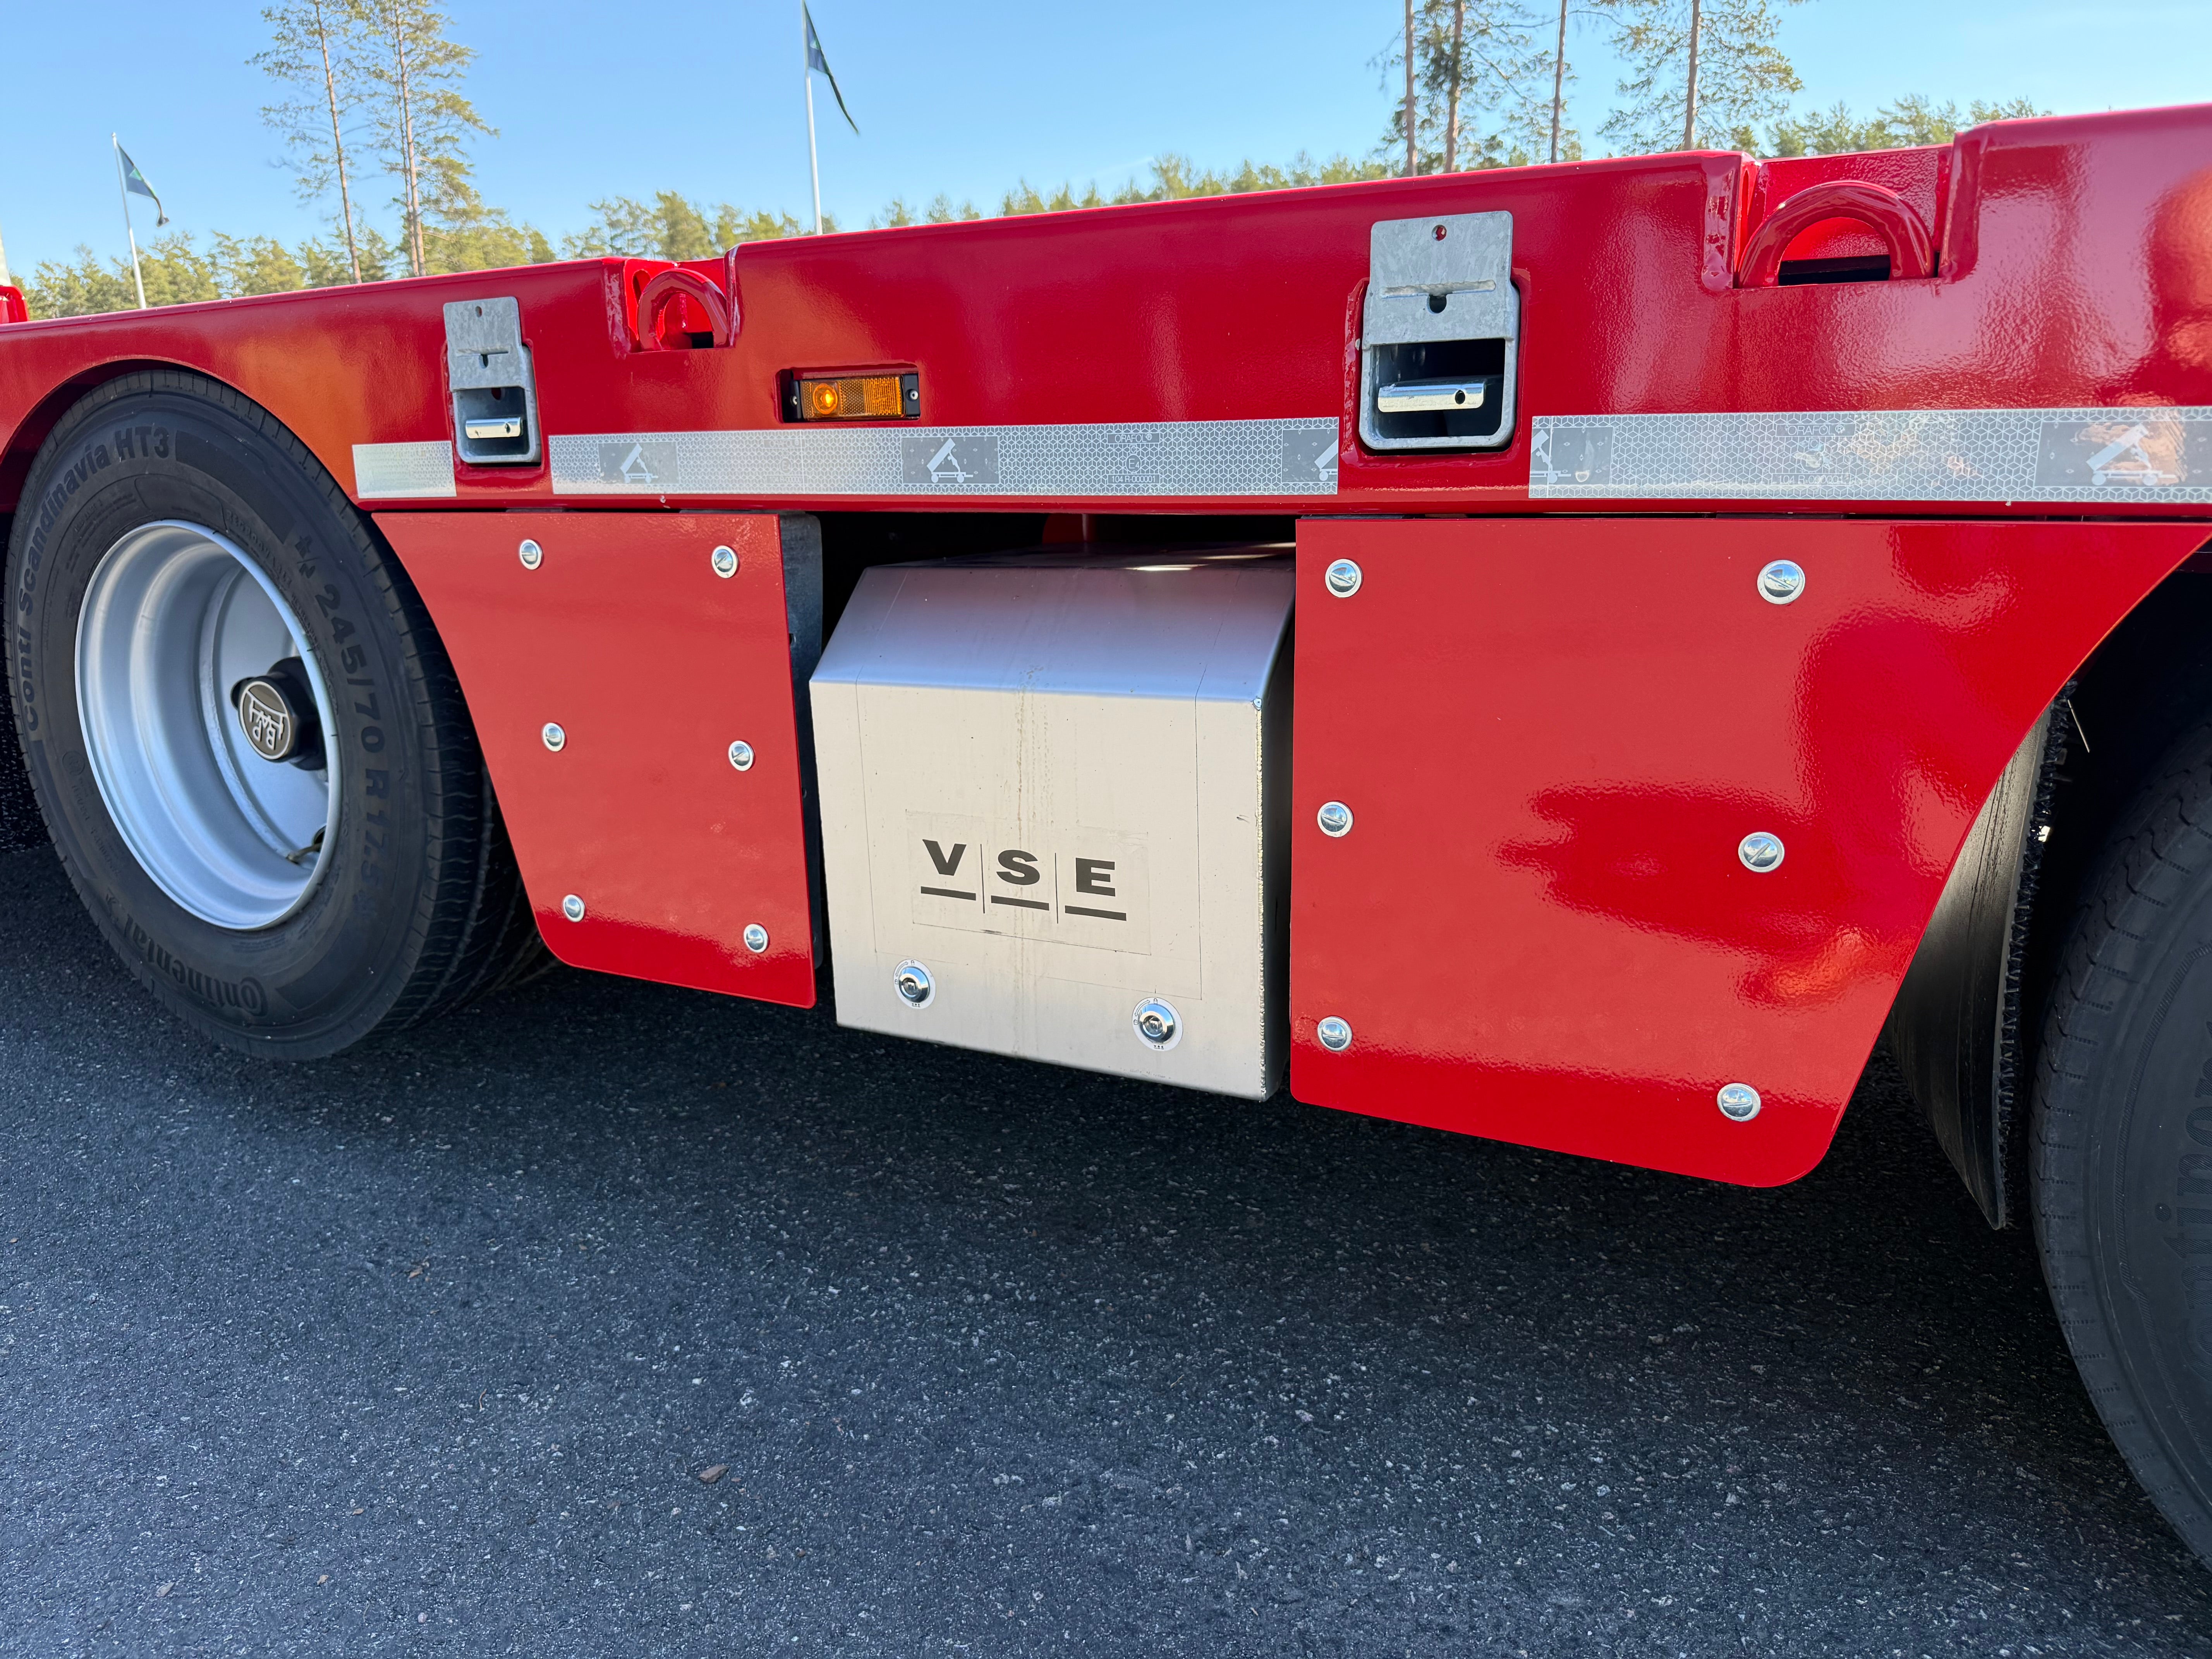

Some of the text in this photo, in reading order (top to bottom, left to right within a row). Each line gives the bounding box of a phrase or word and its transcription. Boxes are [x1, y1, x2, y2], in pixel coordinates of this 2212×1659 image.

[114, 425, 169, 461] HT3
[19, 443, 110, 616] Scandinavia
[18, 628, 38, 732] Conti
[314, 582, 386, 754] 245/70
[124, 913, 268, 1017] Continental
